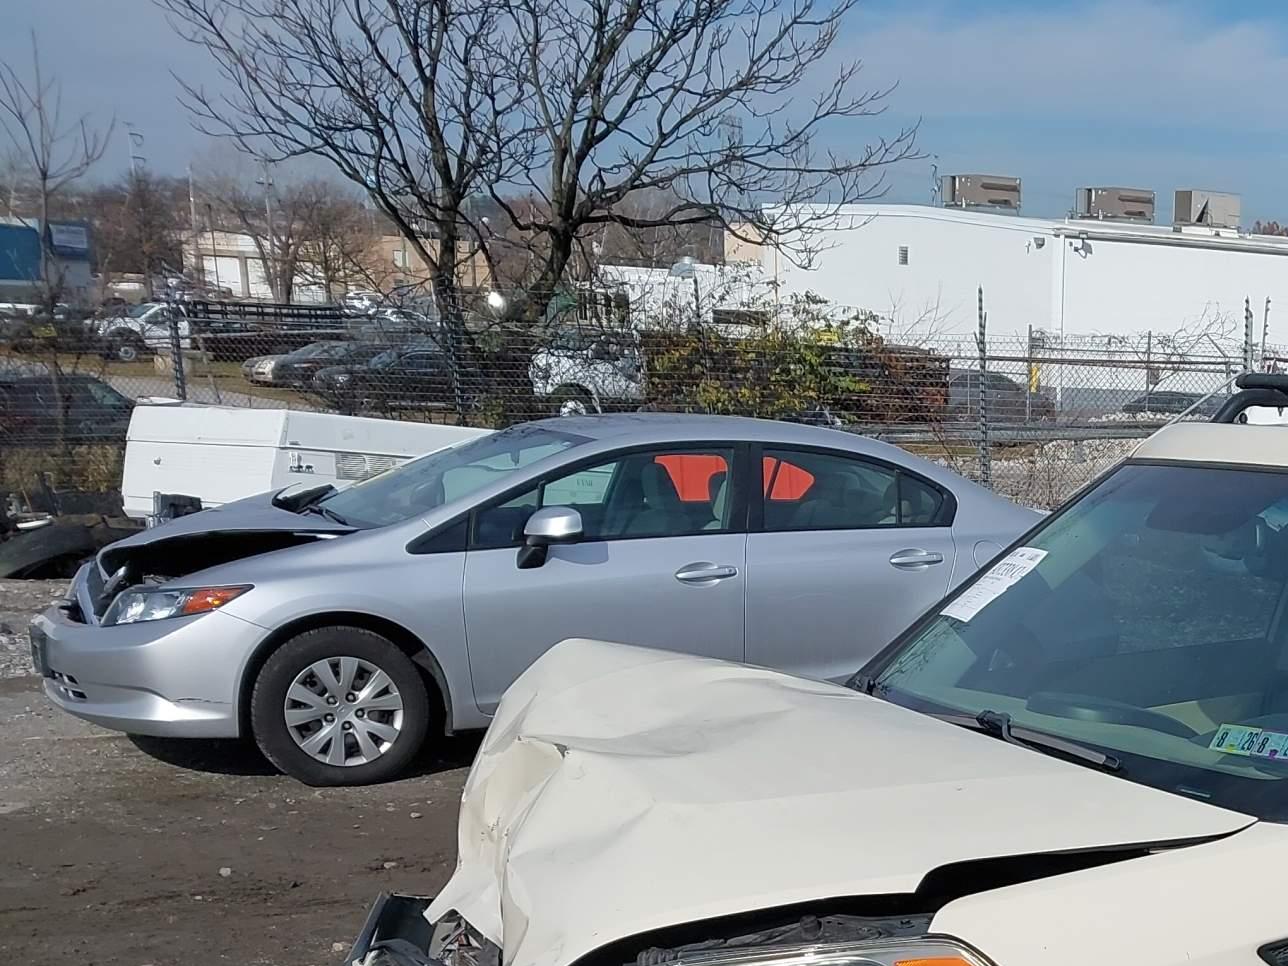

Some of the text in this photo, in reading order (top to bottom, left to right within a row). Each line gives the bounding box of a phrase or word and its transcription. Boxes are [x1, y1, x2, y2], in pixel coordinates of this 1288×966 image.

[1216, 731, 1258, 751] 8 26
[1257, 737, 1269, 753] 8
